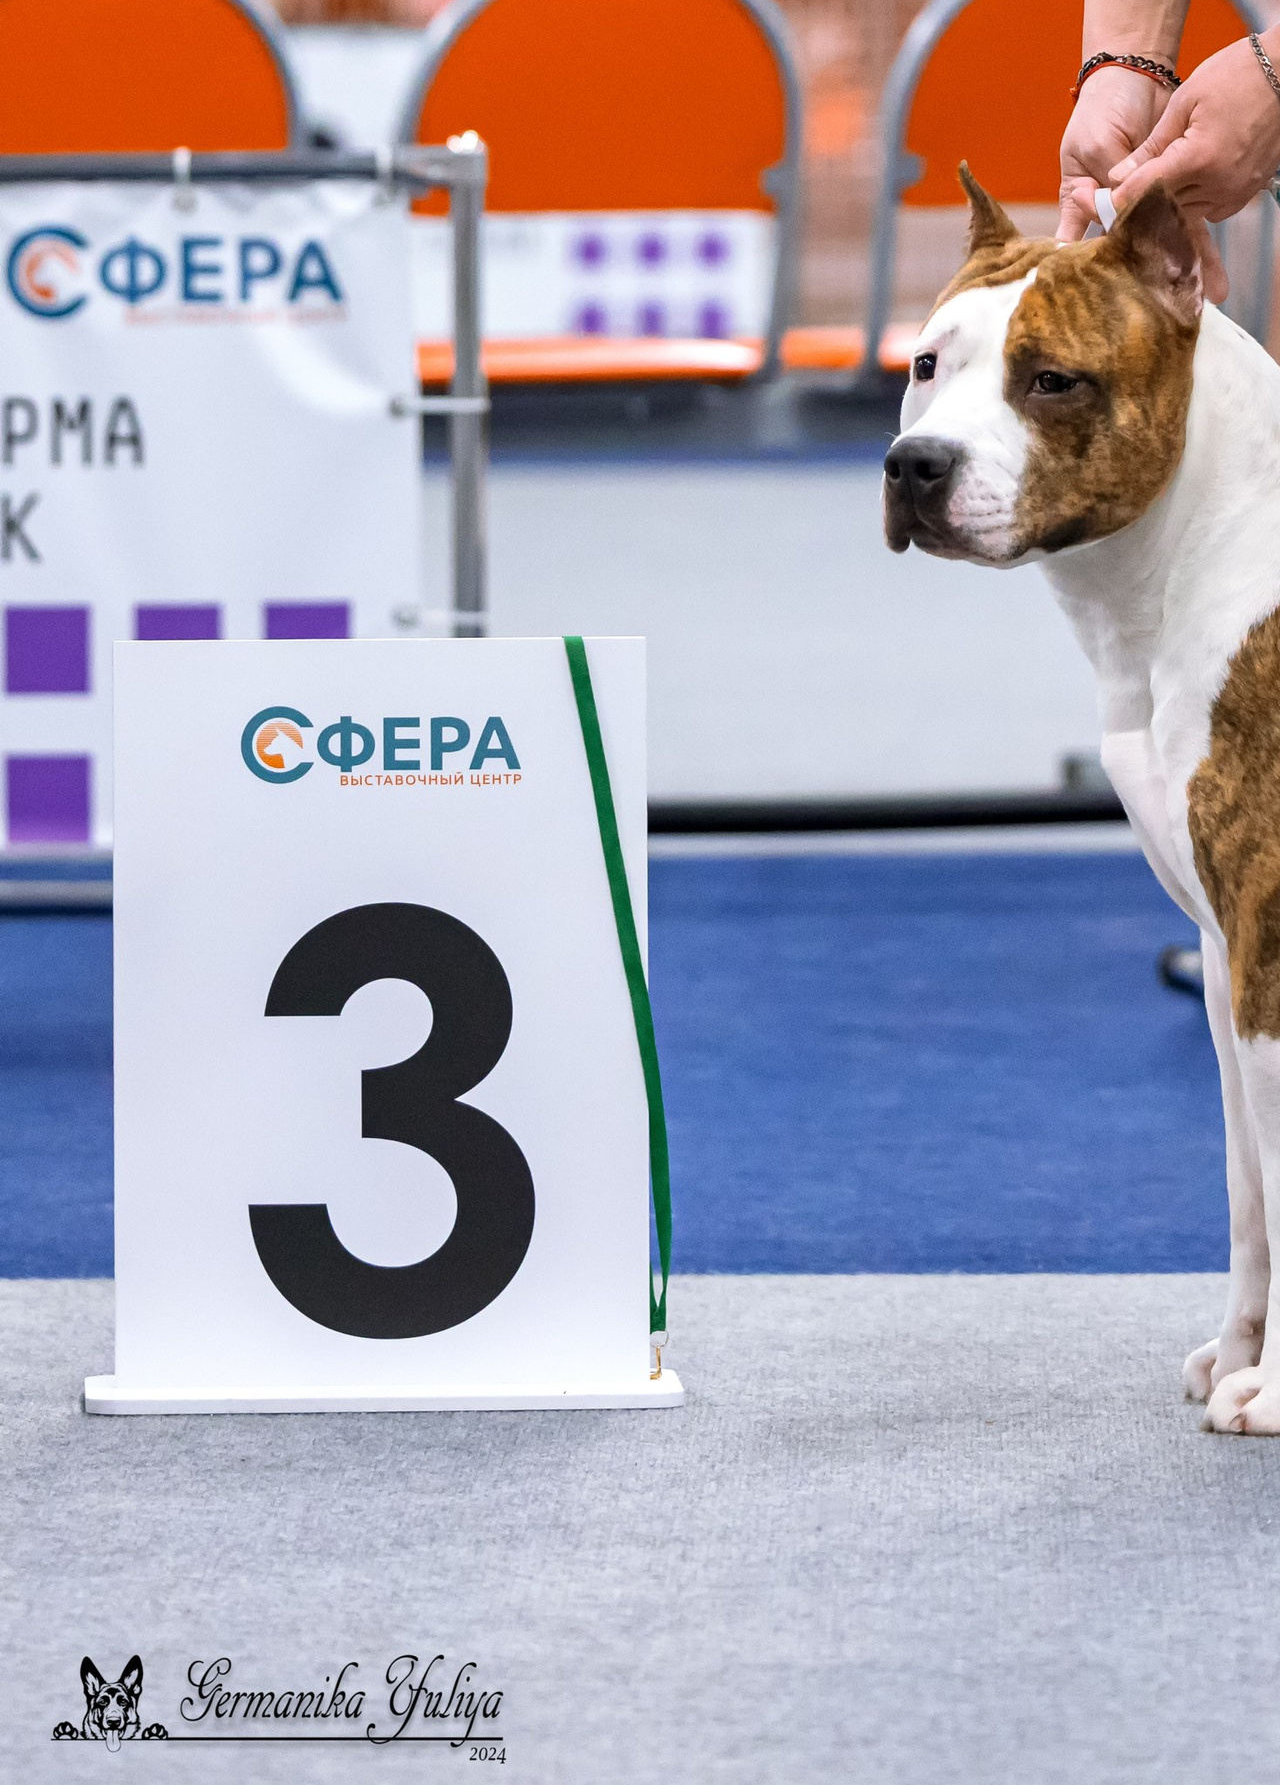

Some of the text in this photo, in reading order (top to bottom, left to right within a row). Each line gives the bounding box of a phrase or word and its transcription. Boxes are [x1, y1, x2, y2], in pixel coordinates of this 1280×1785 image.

[6, 222, 345, 320] СФЕРА
[240, 705, 522, 785] СФЕРА
[339, 771, 523, 788] ВЫСТАВОЧНЫЙ ЦЕНТР
[248, 902, 536, 1340] 3
